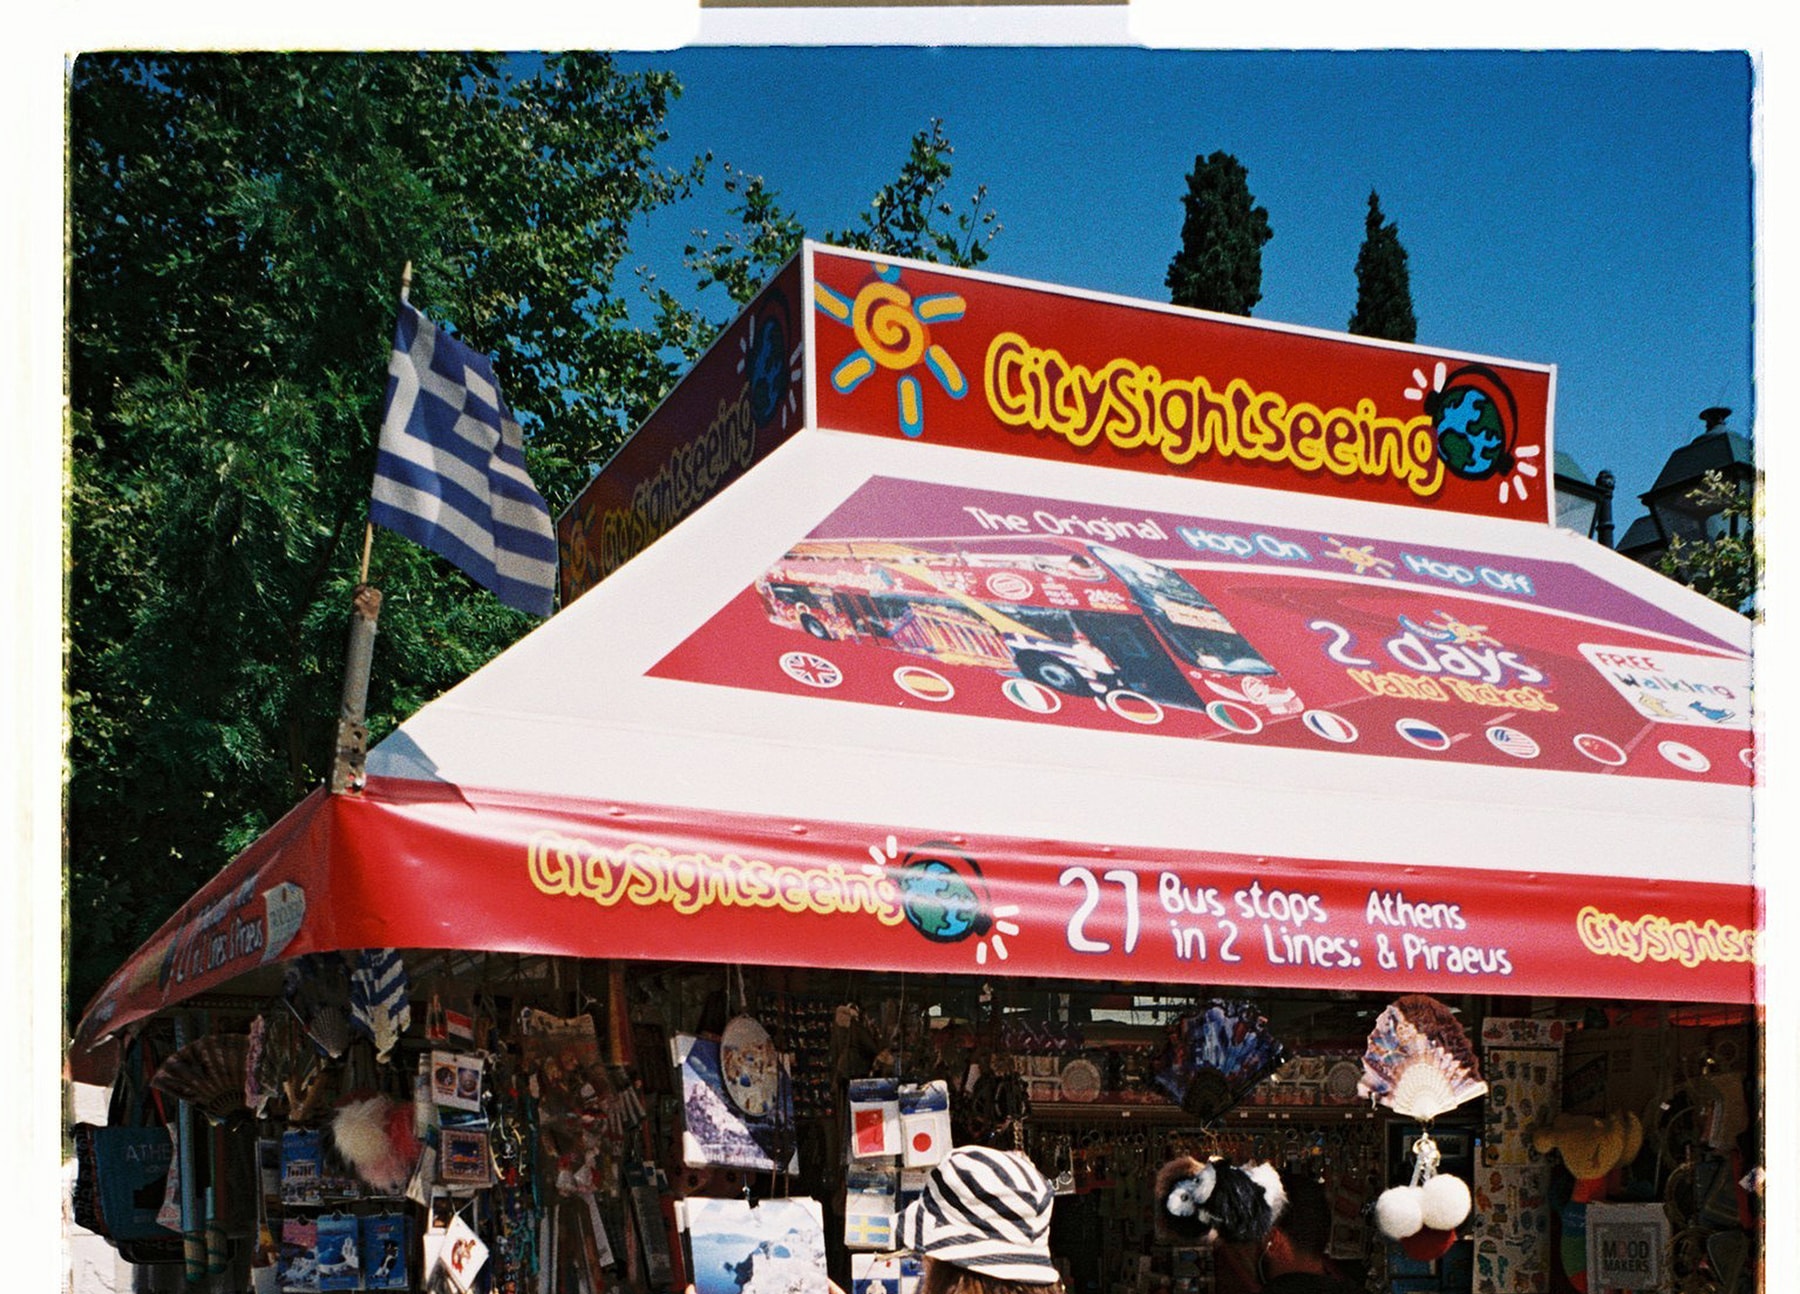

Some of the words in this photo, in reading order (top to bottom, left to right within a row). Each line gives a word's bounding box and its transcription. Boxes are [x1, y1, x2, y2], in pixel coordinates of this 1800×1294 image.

[985, 332, 1445, 497] CitySightseeing
[963, 506, 1031, 533] The
[1032, 510, 1168, 542] Original
[1177, 526, 1254, 558] Hop
[1251, 531, 1312, 562] On
[1402, 551, 1479, 587] Hop
[1475, 563, 1535, 597] Off
[1308, 620, 1373, 667] 2
[1386, 632, 1546, 685] days
[1595, 651, 1664, 673] FREE
[1612, 672, 1737, 701] Walking
[527, 830, 906, 927] CitySightseeing
[1158, 870, 1227, 918] Bus
[1233, 879, 1329, 928] stops
[1058, 865, 1141, 955] 27
[1365, 889, 1468, 931] Athens
[1168, 918, 1207, 960] in
[1217, 919, 1242, 962] 2
[1262, 922, 1363, 968] Lines:
[1375, 932, 1399, 970] &
[1401, 932, 1514, 976] Piraeus
[125, 1143, 171, 1162] ATHE
[1604, 1258, 1650, 1273] MAKERS
